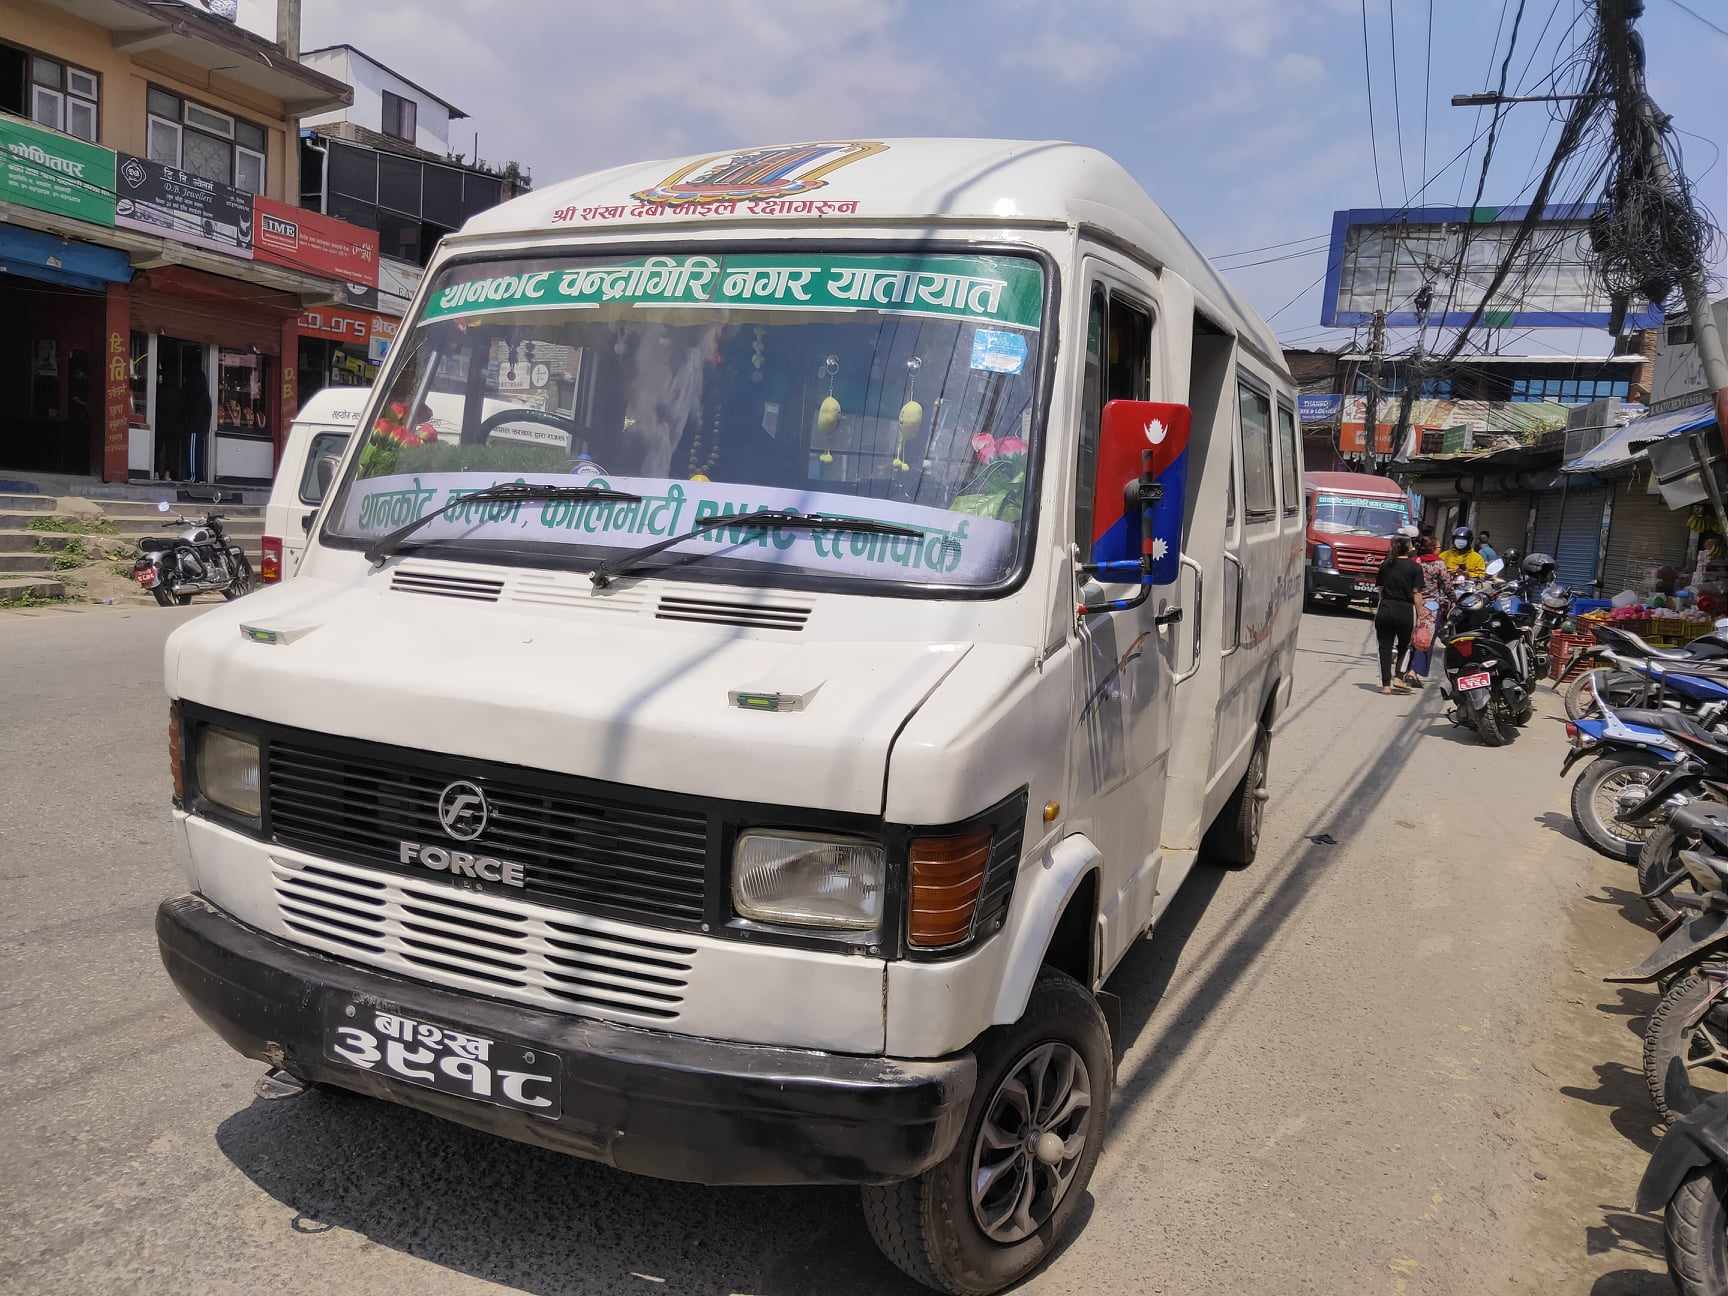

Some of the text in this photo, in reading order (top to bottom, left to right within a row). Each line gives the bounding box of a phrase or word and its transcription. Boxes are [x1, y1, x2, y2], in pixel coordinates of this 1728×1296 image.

[182, 188, 212, 203] Jewellers
[268, 220, 295, 237] IME
[551, 205, 578, 223] श्री
[559, 256, 720, 301] चन्द्रागिरि
[723, 267, 821, 301] नगर
[827, 267, 1007, 313] यातायात
[690, 499, 800, 551] RNAC
[400, 841, 524, 888] FORCE
